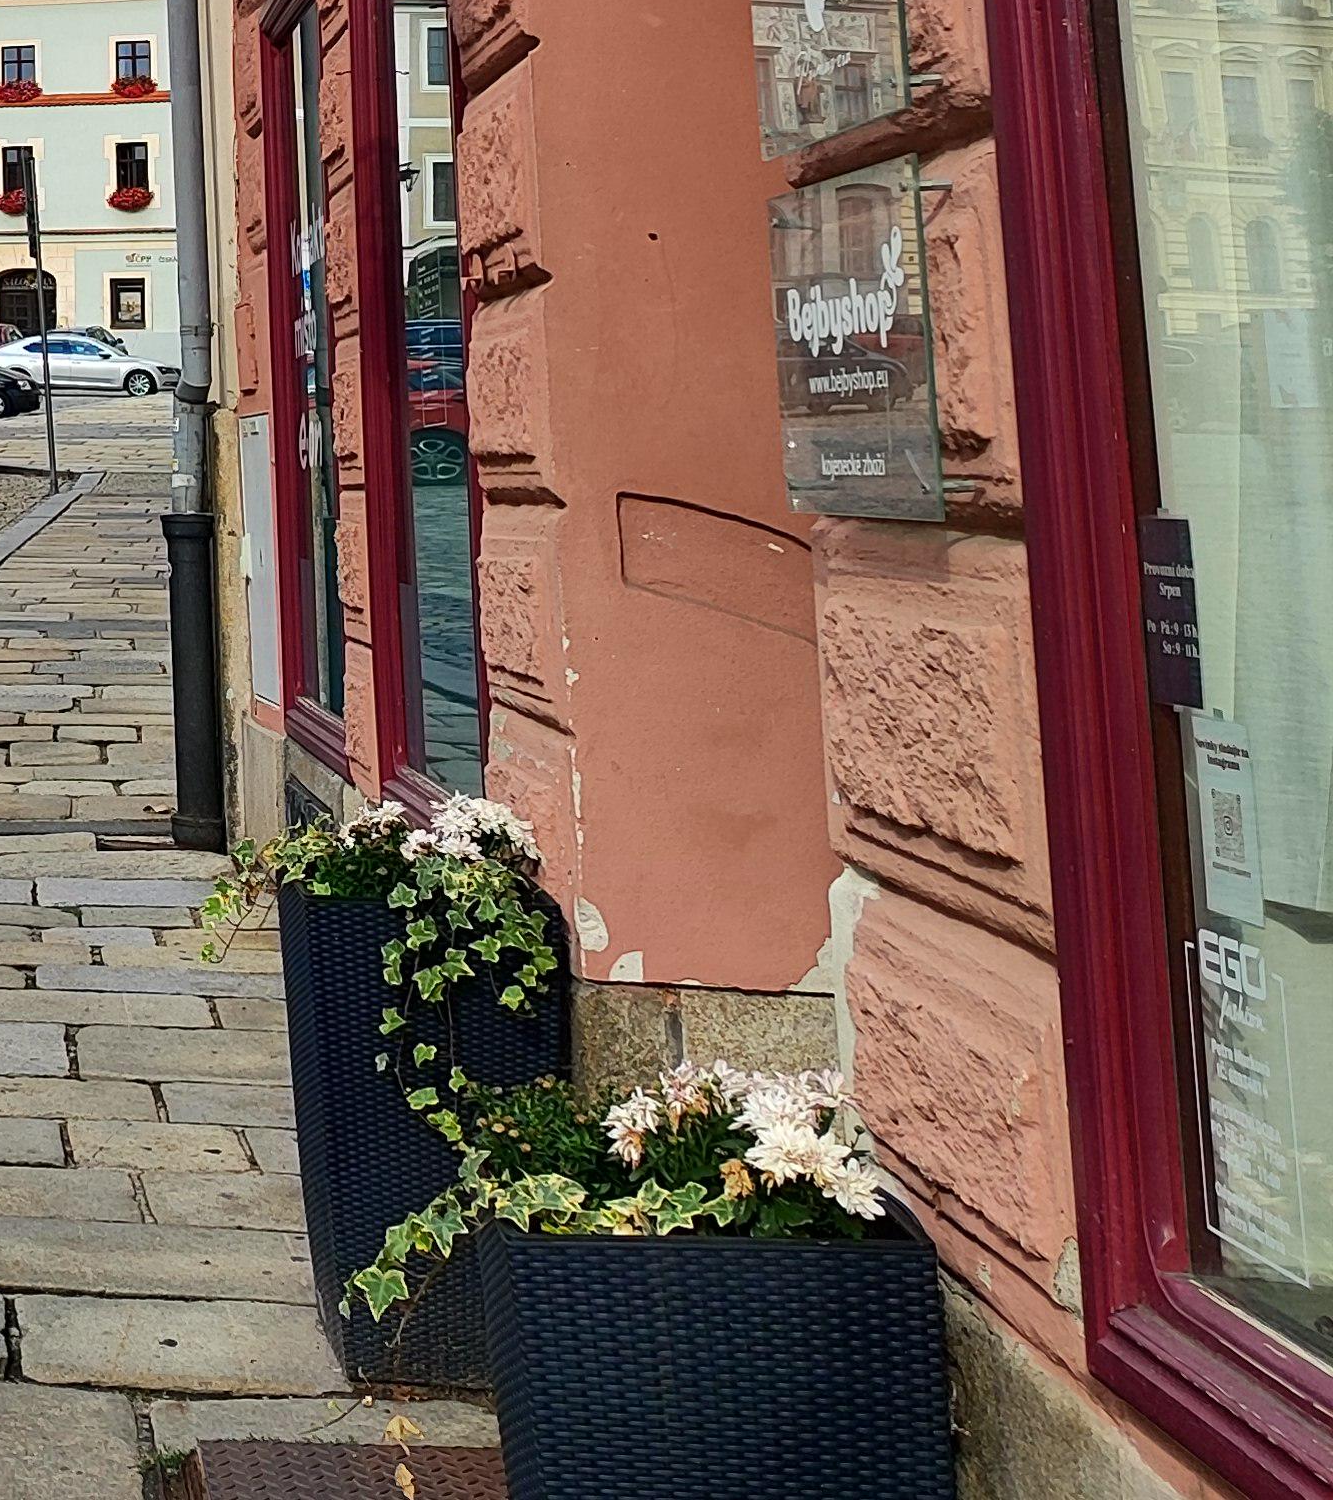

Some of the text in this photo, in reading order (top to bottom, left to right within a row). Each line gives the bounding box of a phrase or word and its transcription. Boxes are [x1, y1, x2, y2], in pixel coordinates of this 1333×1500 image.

[787, 278, 895, 358] Bejbyshop
[808, 366, 889, 397] www.bejbyshop.eu
[1159, 582, 1182, 600] Srpen
[1199, 928, 1267, 1001] EGO
